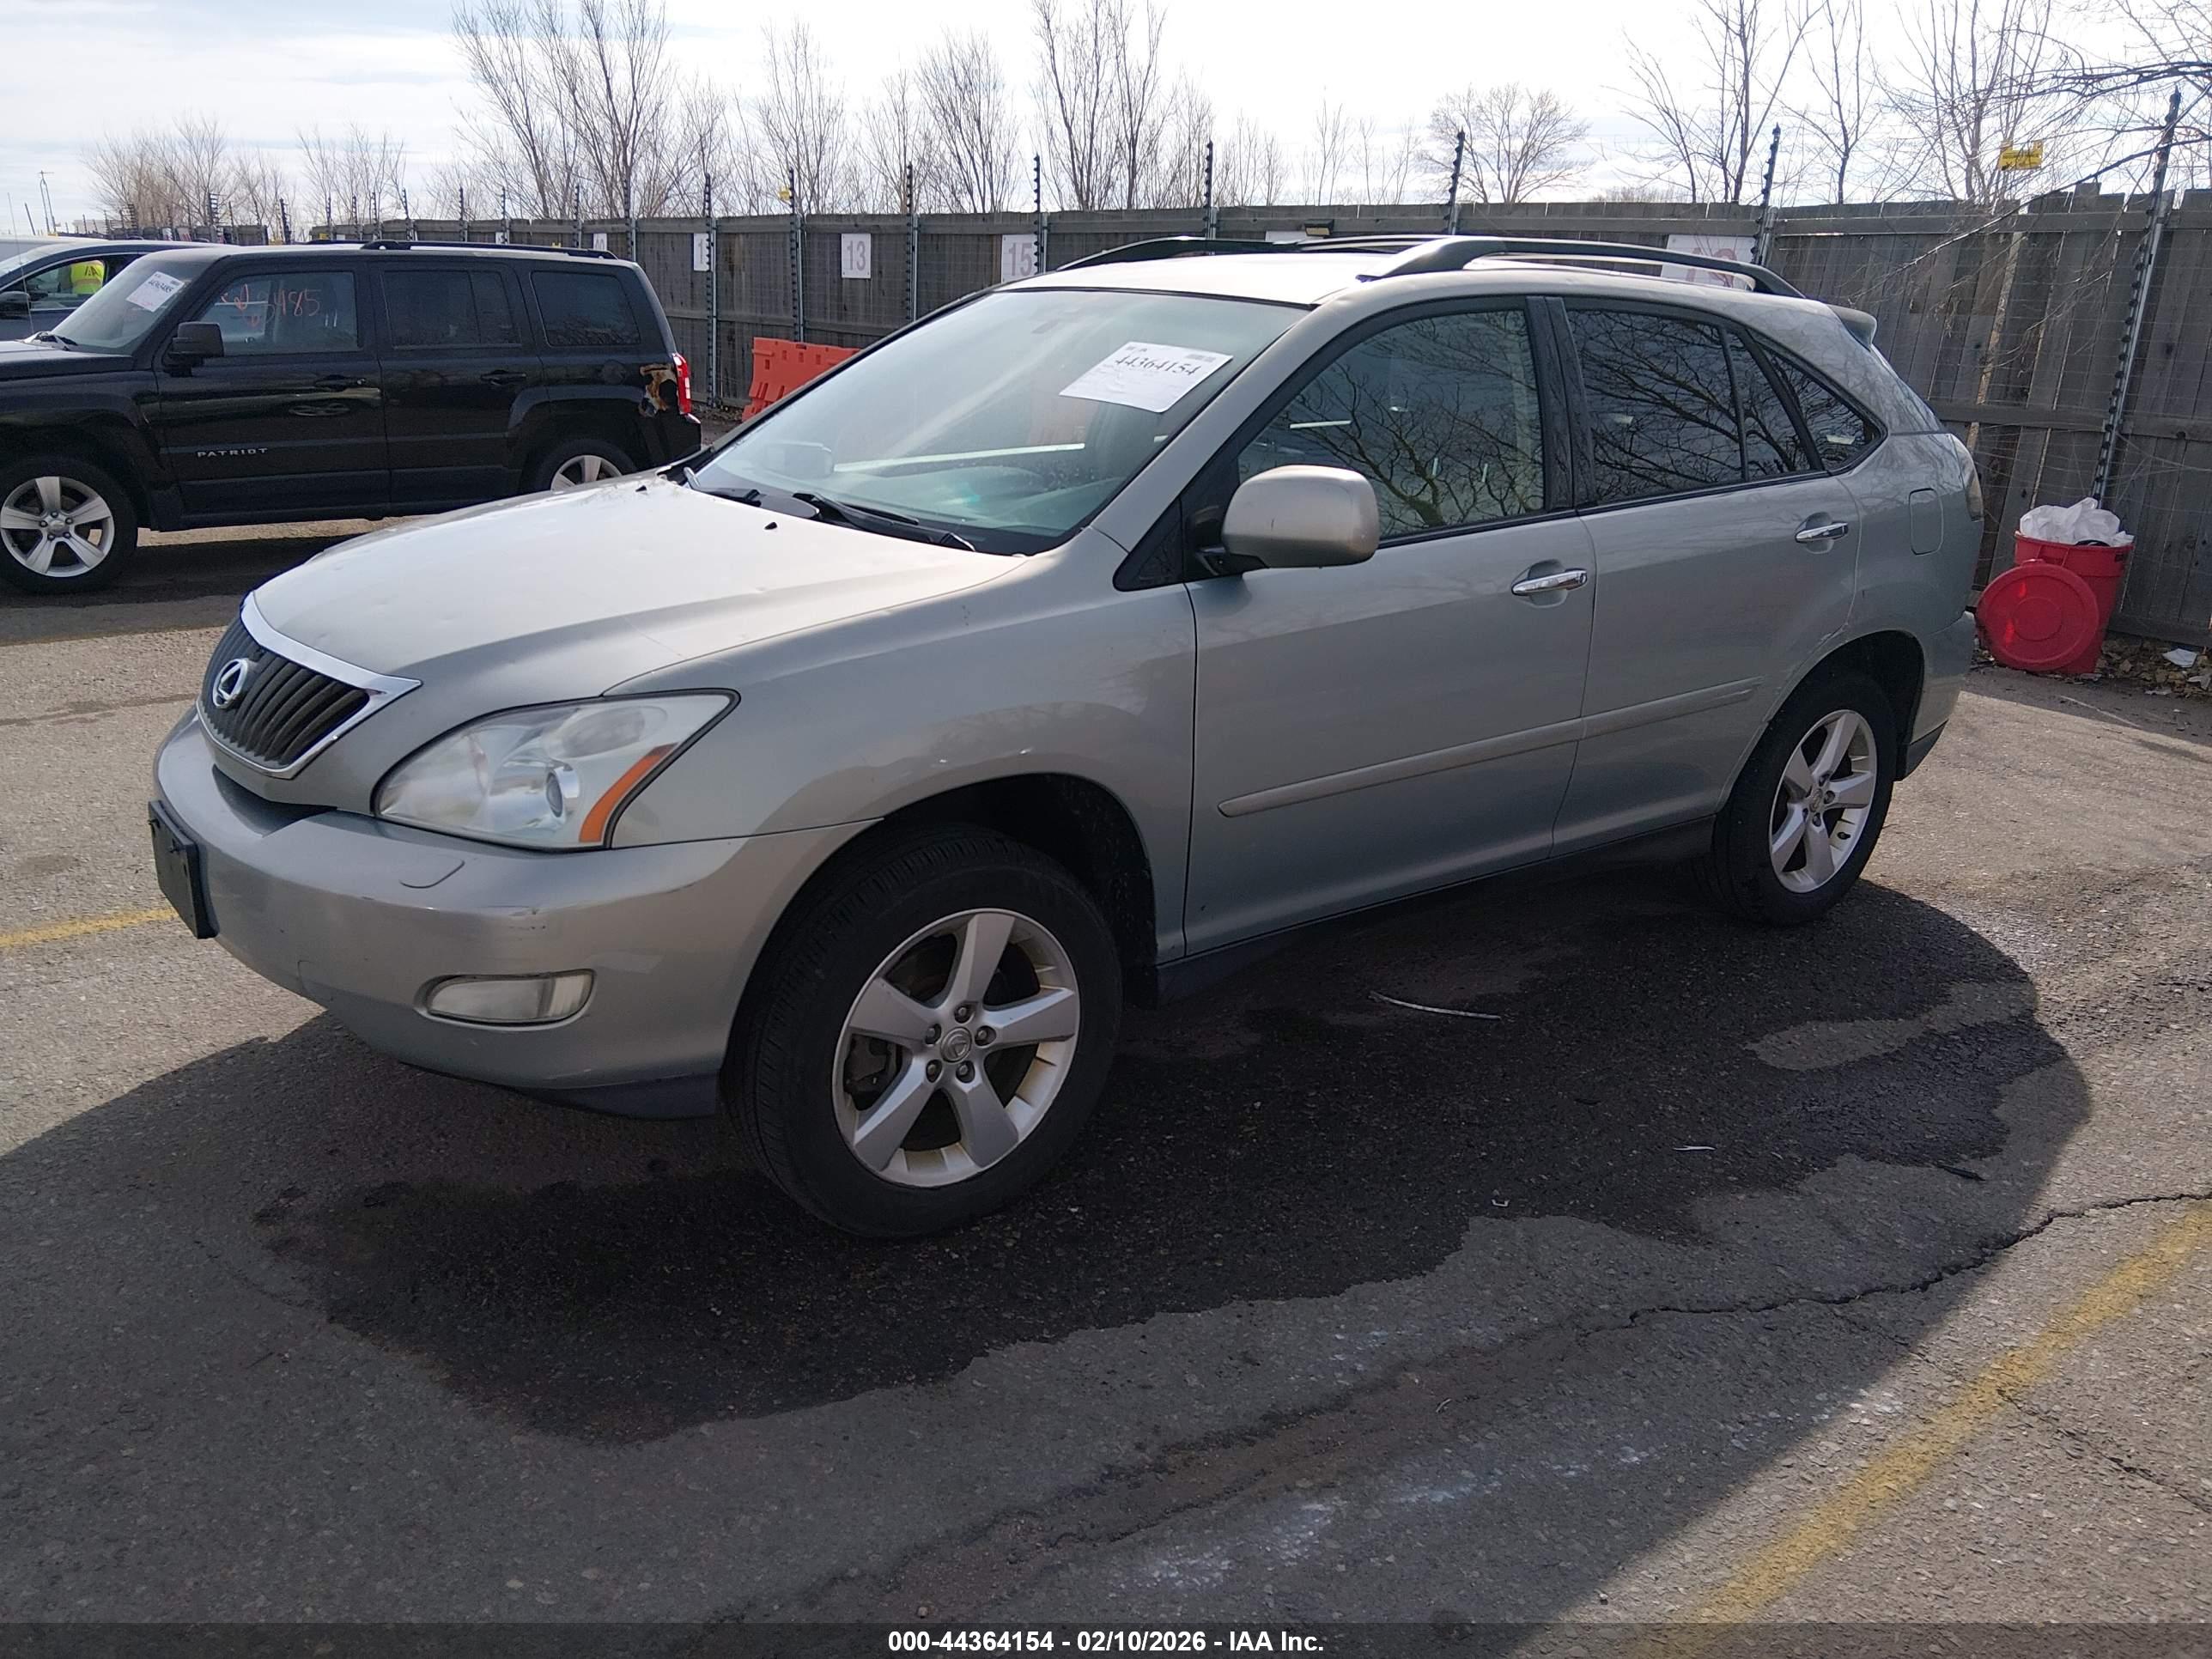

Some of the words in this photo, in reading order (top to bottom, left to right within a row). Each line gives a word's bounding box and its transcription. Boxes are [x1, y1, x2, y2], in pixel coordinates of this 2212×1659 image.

[846, 240, 866, 272] 13
[1008, 241, 1033, 276] 15
[1115, 355, 1202, 376] 44364154
[197, 447, 268, 458] PATRIOT
